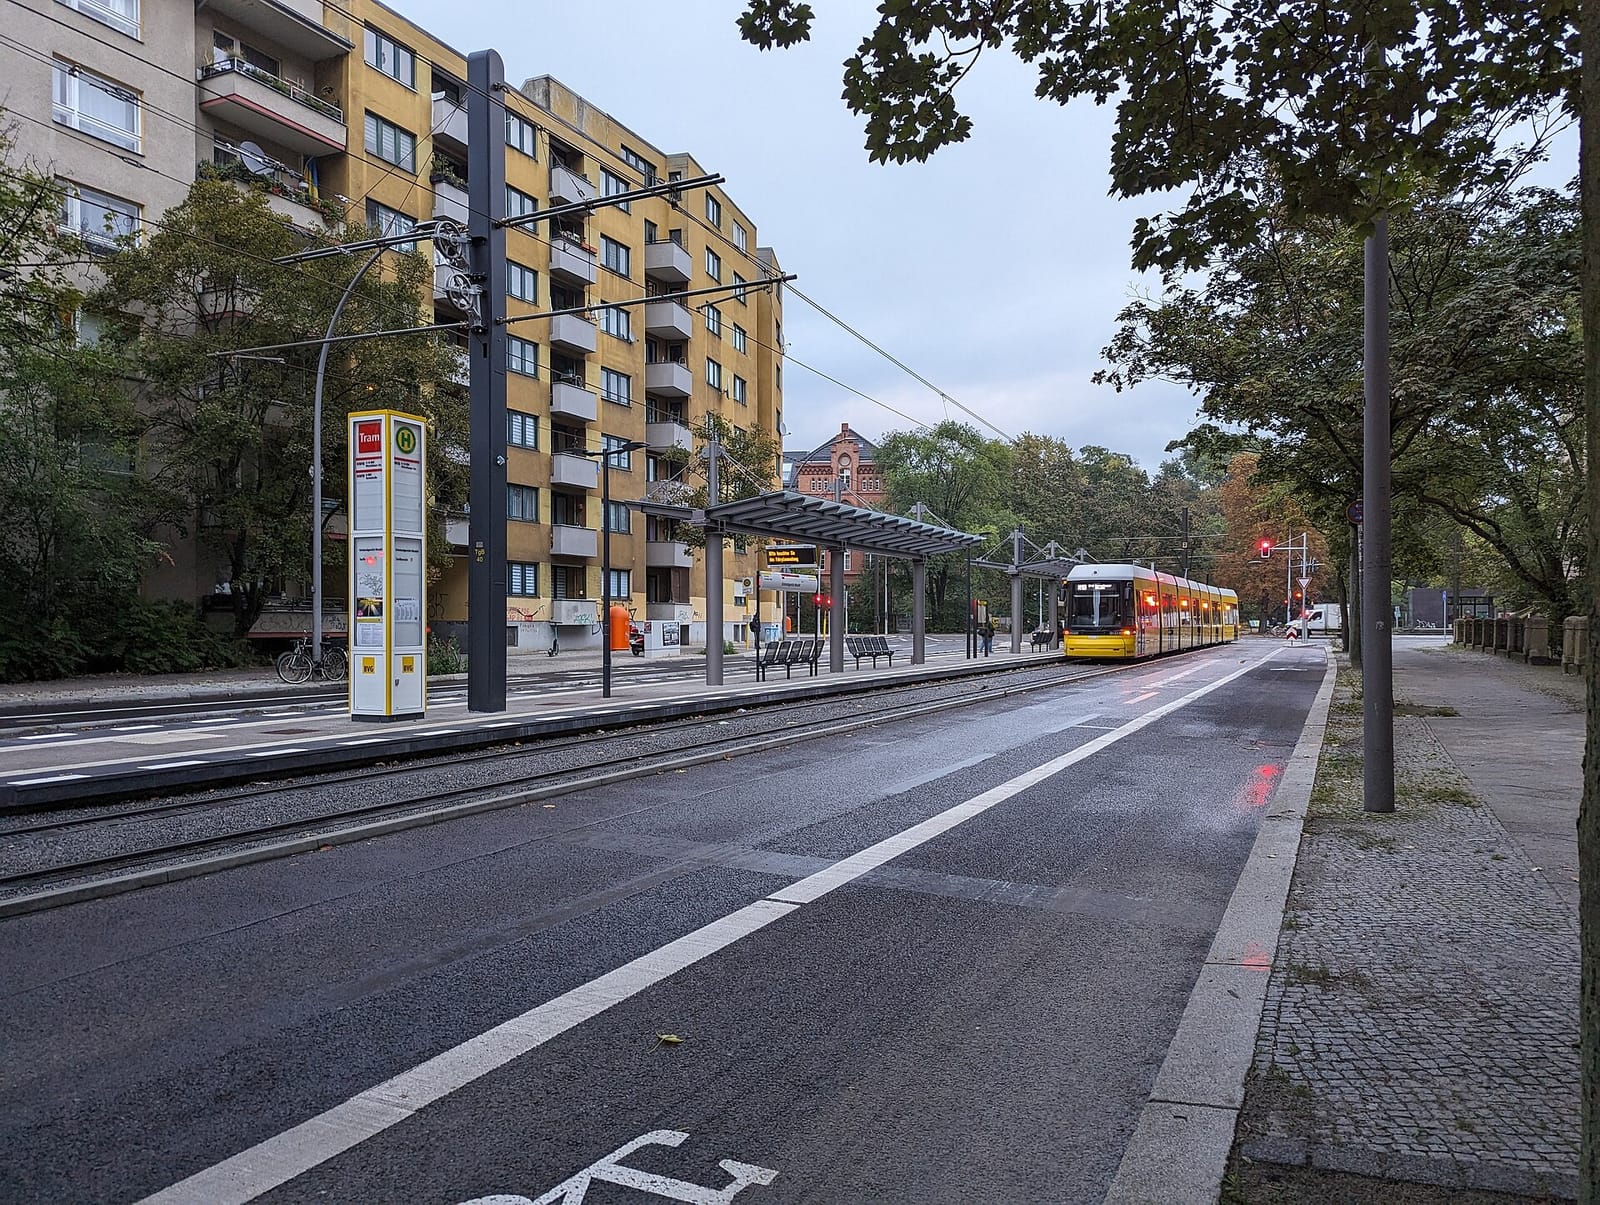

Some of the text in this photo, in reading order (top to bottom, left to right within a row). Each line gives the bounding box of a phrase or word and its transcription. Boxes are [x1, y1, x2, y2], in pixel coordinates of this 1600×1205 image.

[359, 432, 380, 443] Tram
[401, 432, 411, 448] H
[363, 665, 375, 673] BVG
